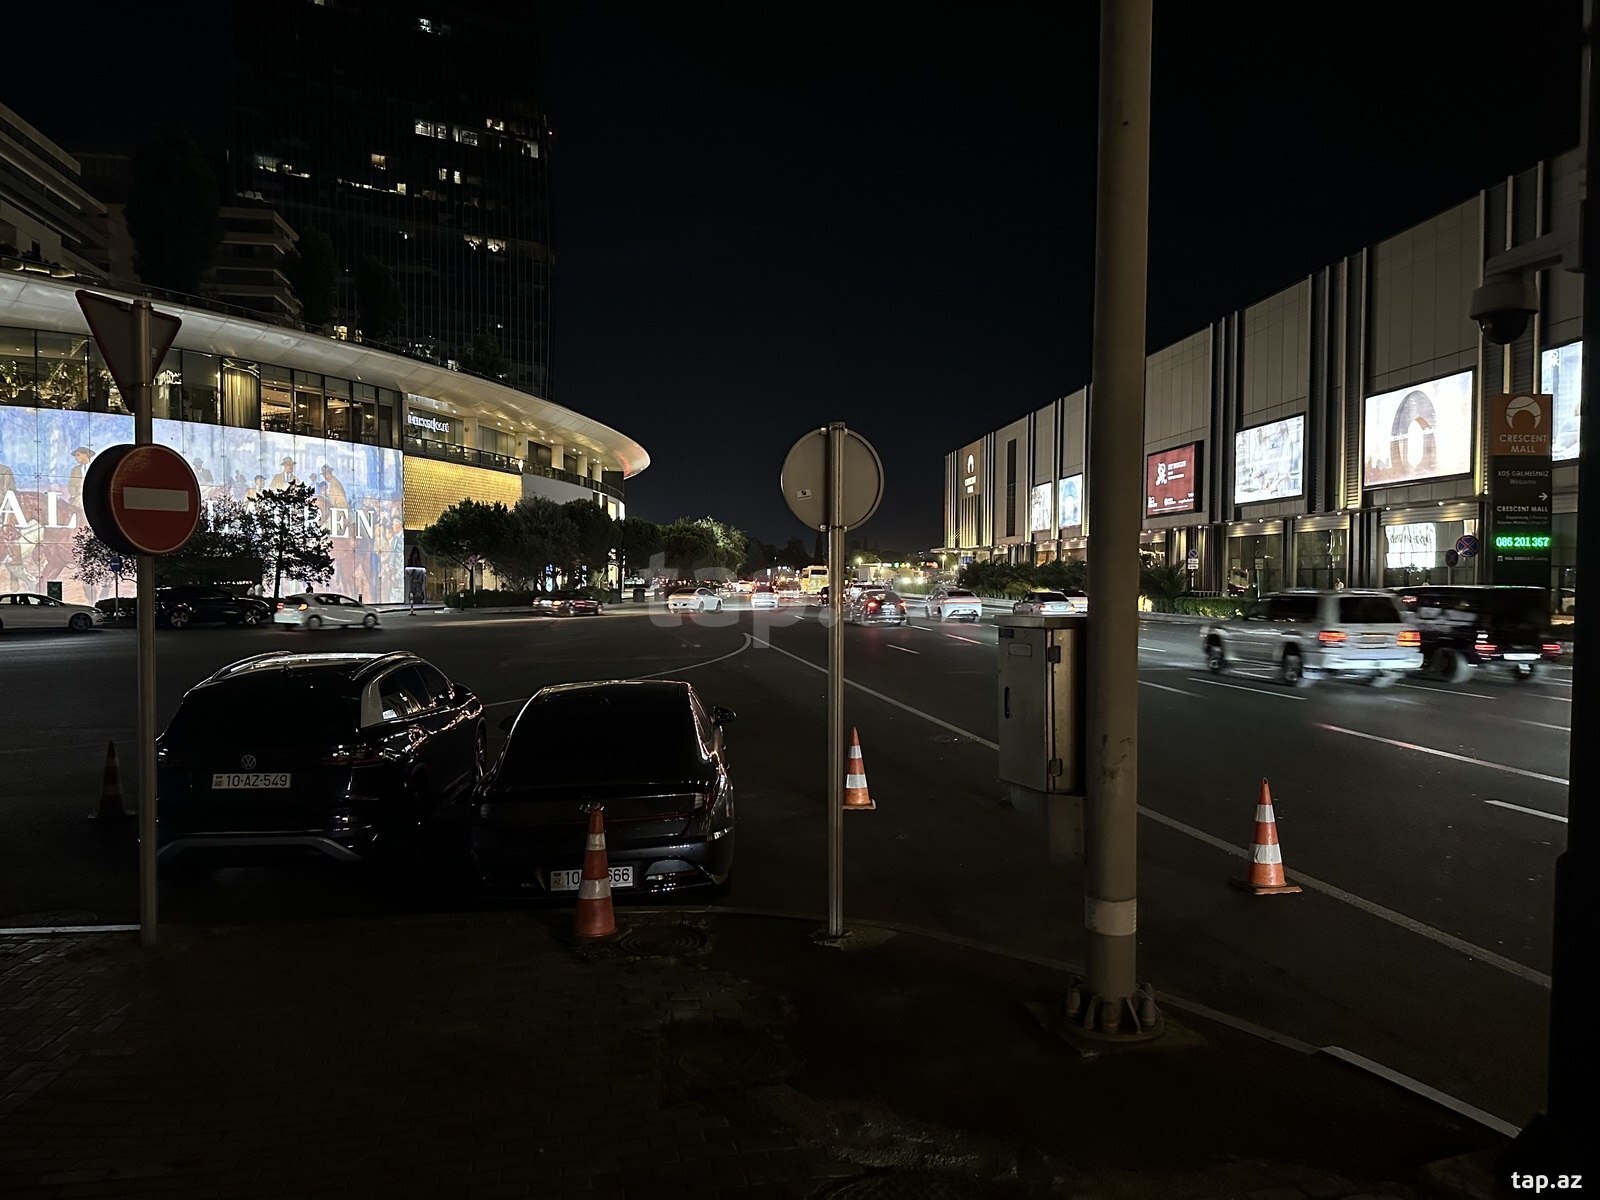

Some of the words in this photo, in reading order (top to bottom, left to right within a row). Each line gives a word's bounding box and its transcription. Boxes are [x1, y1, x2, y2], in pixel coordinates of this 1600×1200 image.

[1499, 434, 1547, 443] CRESCENT
[1510, 445, 1536, 453] MALL
[1513, 536, 1531, 547] 201
